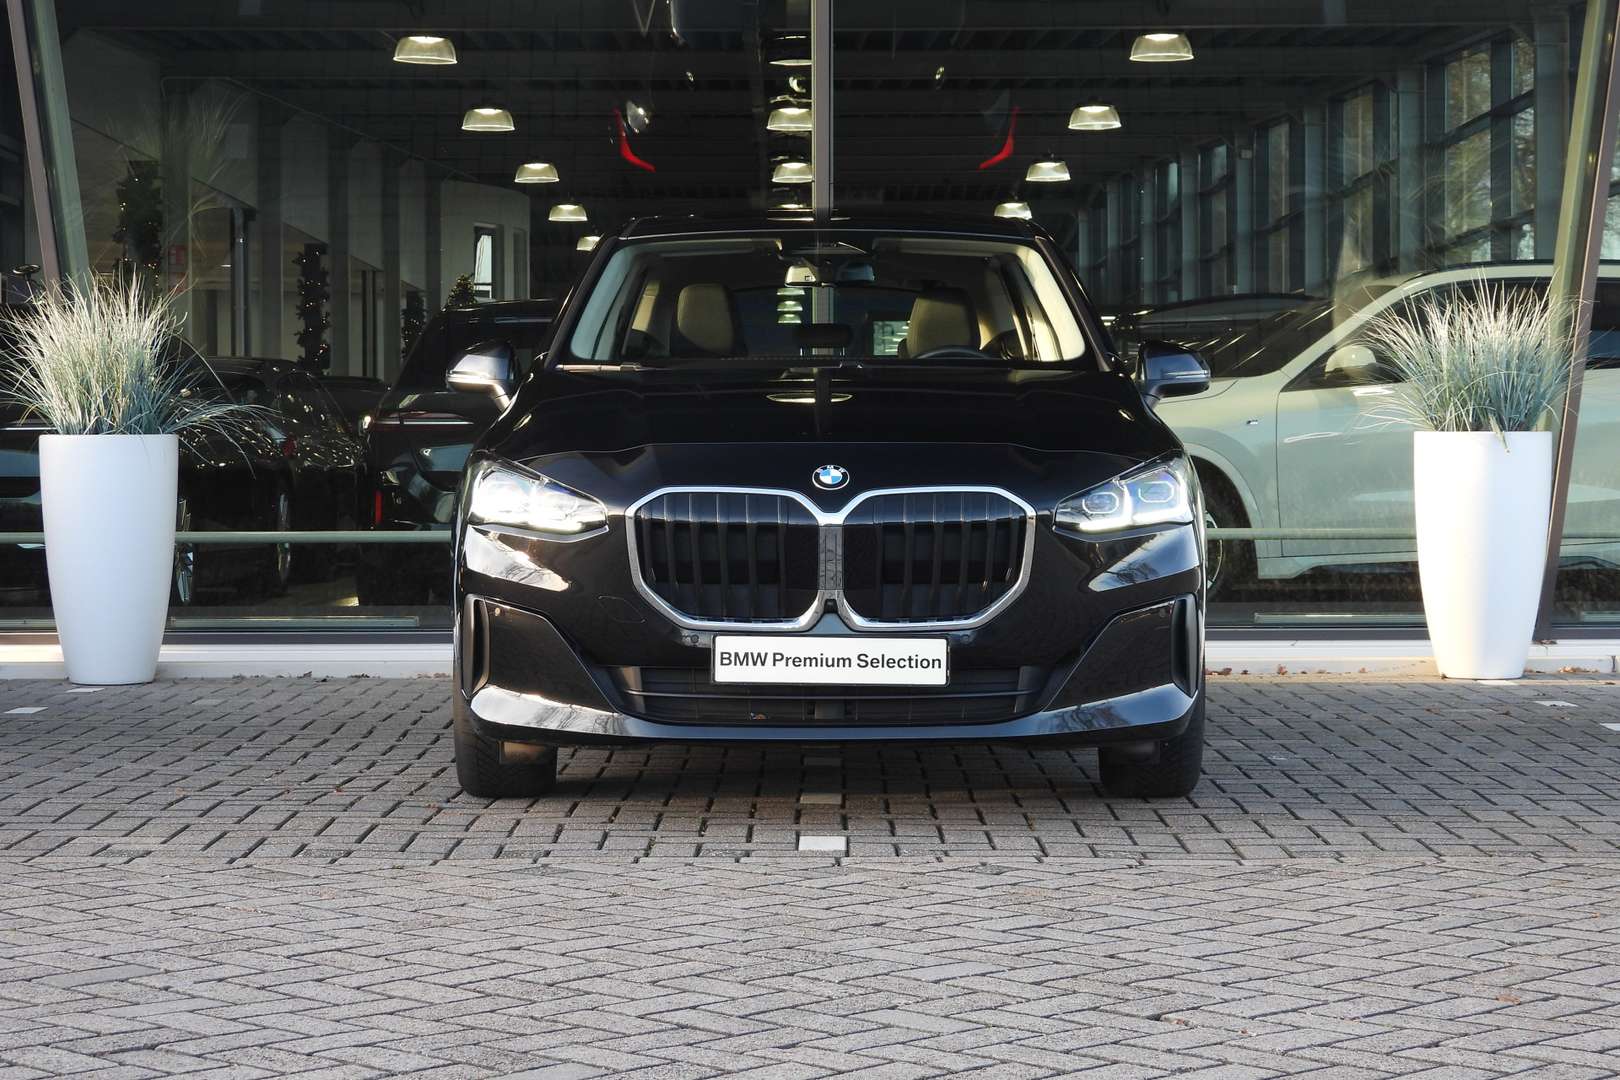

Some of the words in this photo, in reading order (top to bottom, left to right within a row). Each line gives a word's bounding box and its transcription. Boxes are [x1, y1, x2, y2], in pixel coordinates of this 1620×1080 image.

[719, 651, 769, 667] BMW
[772, 652, 852, 668] Premium
[856, 653, 942, 669] Selection
